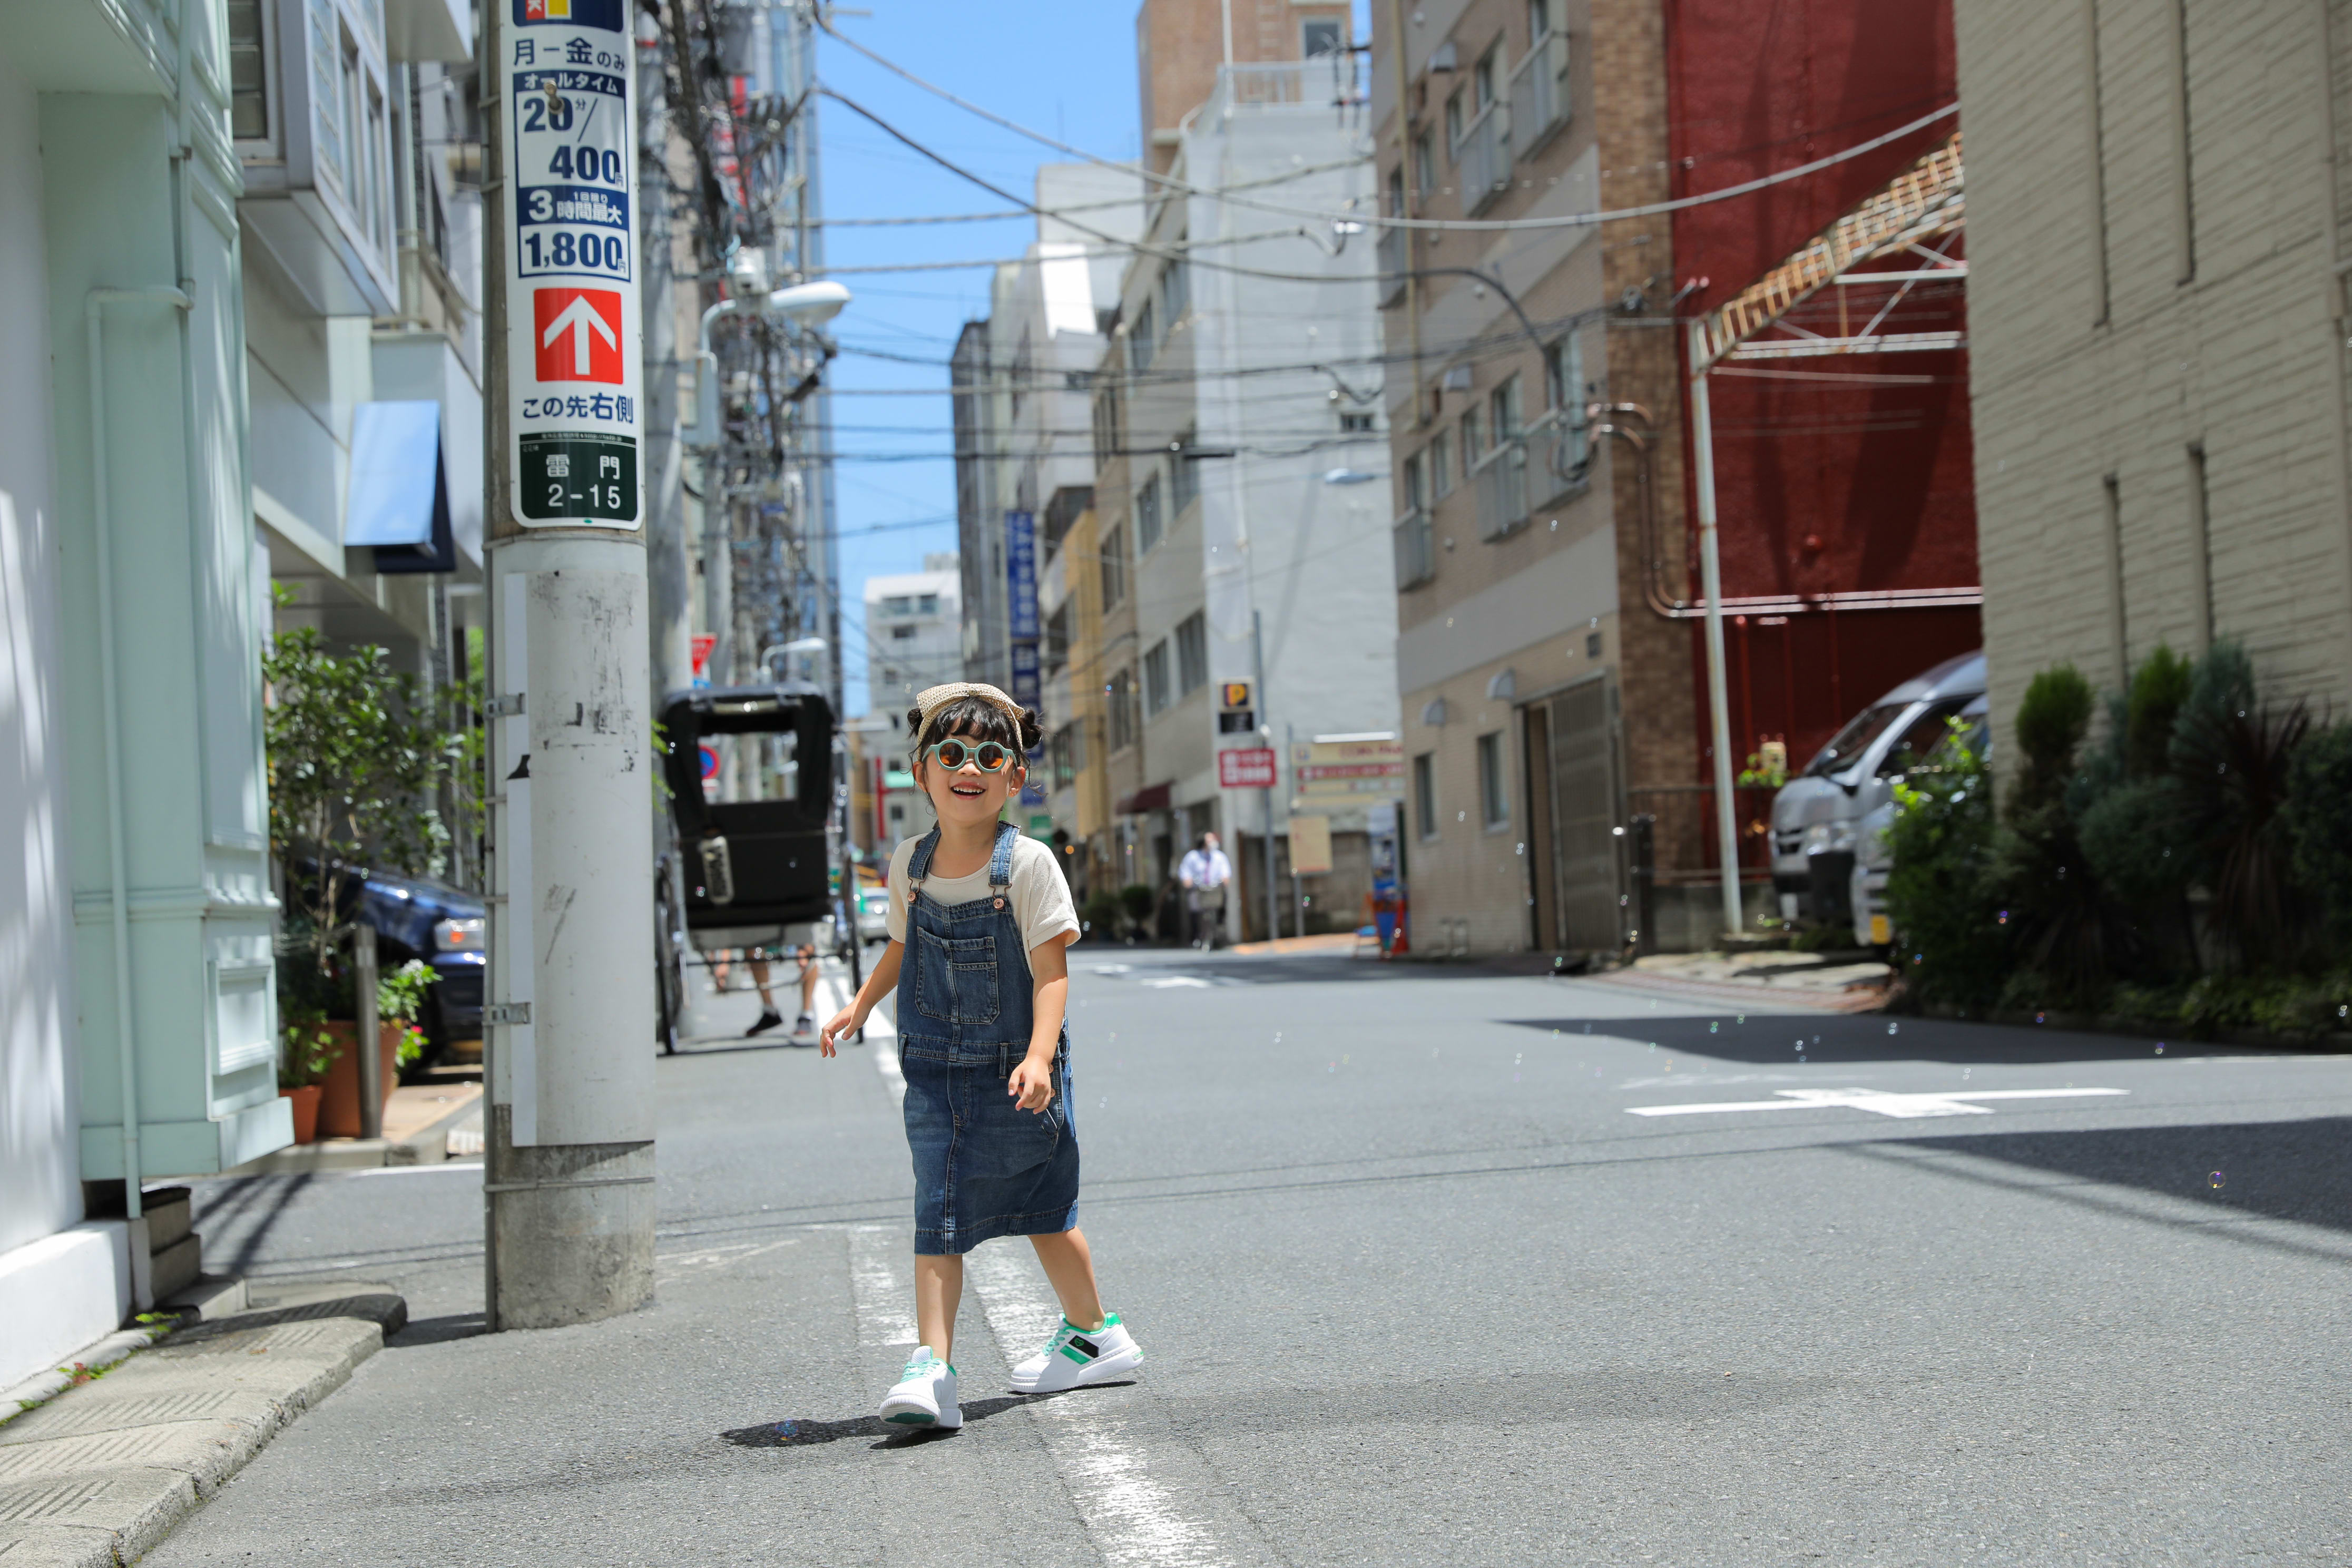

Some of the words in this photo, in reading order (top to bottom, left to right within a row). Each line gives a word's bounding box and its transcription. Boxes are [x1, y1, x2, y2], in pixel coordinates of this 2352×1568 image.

[523, 392, 633, 424] この先右側
[546, 454, 621, 479] 雷門
[547, 484, 621, 509] 2-15
